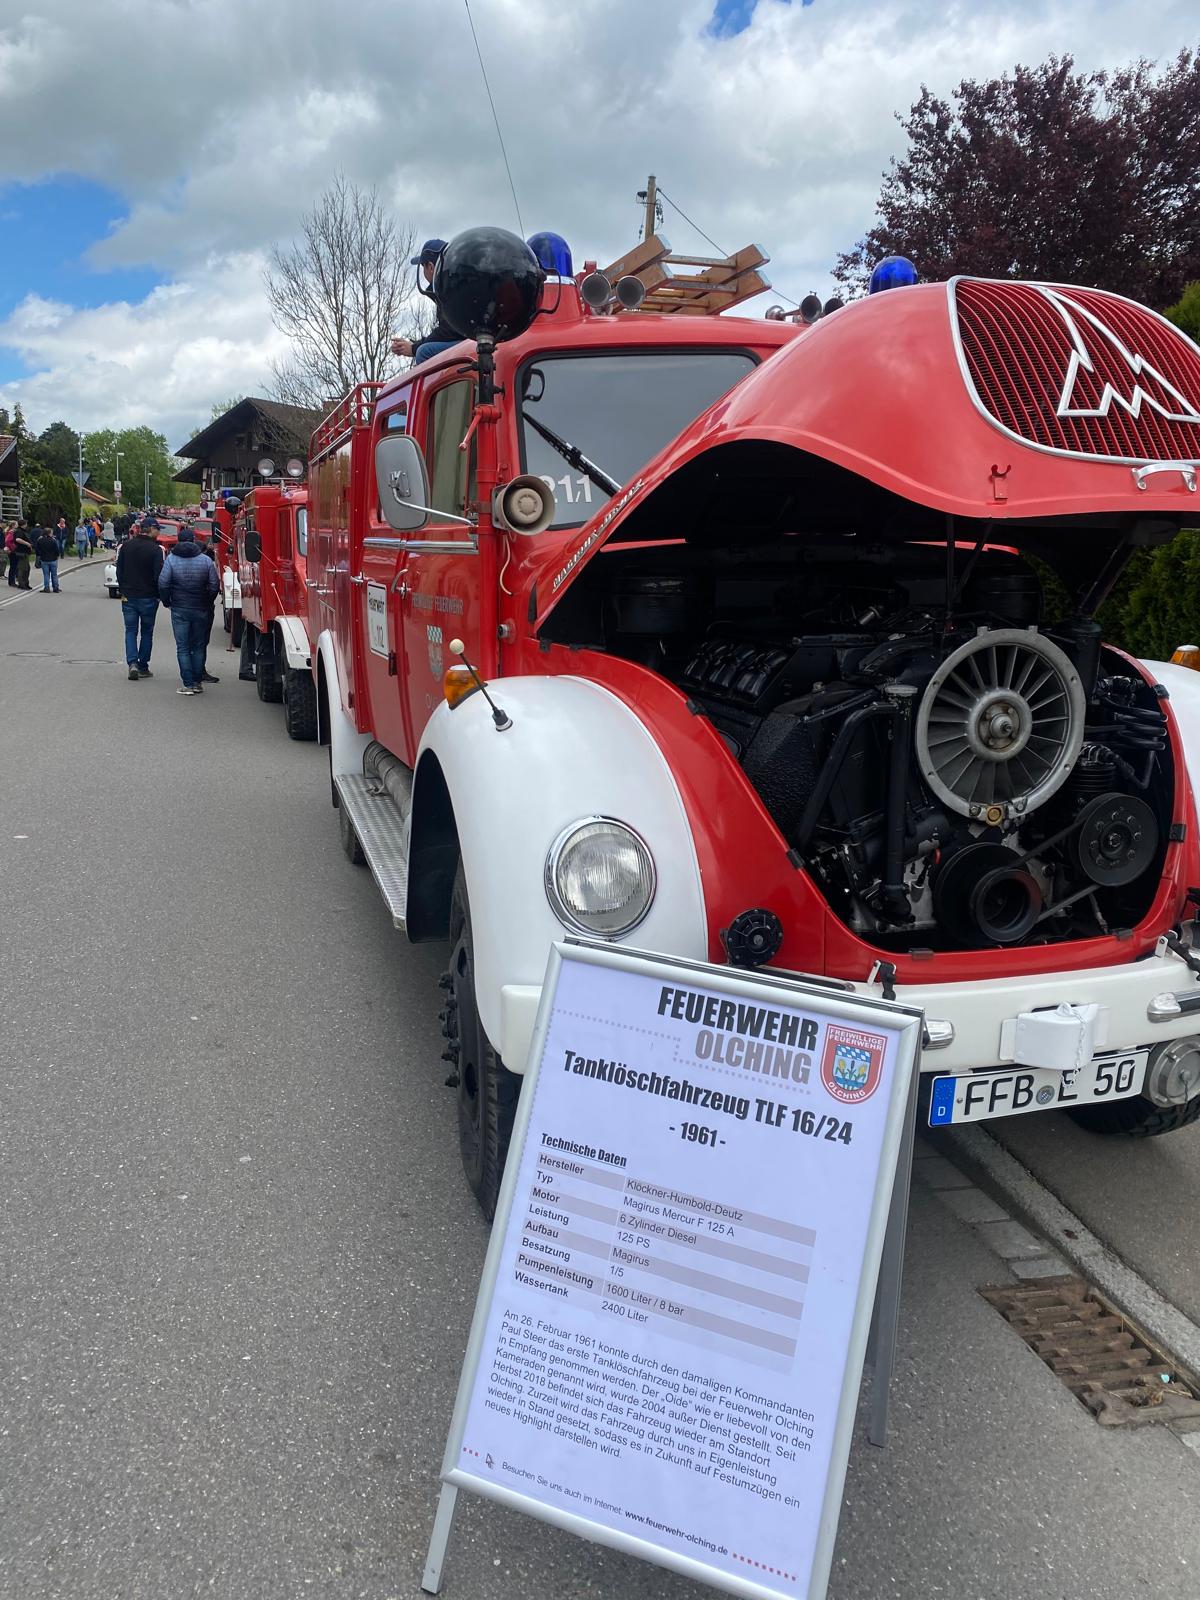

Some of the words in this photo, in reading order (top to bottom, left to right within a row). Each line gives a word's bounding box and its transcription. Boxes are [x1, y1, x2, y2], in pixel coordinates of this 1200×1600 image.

[657, 986, 818, 1051] FEUERWEHR
[829, 1034, 883, 1051] FEUERWEHR
[830, 1028, 883, 1046] FREIWILLIGE
[694, 1029, 811, 1085] OLCHING
[564, 1049, 750, 1120] Tanklöschfahrzeug
[755, 1098, 788, 1127] TLF
[791, 1108, 852, 1145] 16/24
[828, 1081, 866, 1099] OLCHING
[937, 1106, 946, 1117] D
[963, 1074, 1035, 1116] FFB
[1093, 1059, 1136, 1096] 50
[541, 1132, 596, 1158] Technische
[597, 1148, 627, 1167] Daten
[680, 1121, 717, 1147] 1961
[532, 1186, 560, 1203] Motor
[618, 1211, 626, 1223] 6
[627, 1215, 666, 1234] Zylinder
[667, 1227, 696, 1244] Diesel
[536, 1170, 553, 1184] Typ
[623, 1195, 660, 1215] Magirus
[662, 1207, 695, 1224] Mercur
[697, 1217, 704, 1227] F
[707, 1220, 725, 1234] 125
[726, 1226, 734, 1237] A
[539, 1153, 584, 1174] Hersteller
[627, 1179, 743, 1221] Klöckner-Humbold-Deutz
[524, 1220, 558, 1238] Aufbau
[612, 1247, 650, 1266] Magirus
[528, 1203, 569, 1226] Leistung
[617, 1230, 634, 1243] 125
[635, 1235, 650, 1248] PS
[518, 1253, 593, 1289] Pumpenleistung
[607, 1283, 630, 1298] 1600
[630, 1290, 652, 1305] Liter
[659, 1299, 666, 1310] 8
[667, 1301, 684, 1316] bar
[521, 1236, 570, 1262] Besatzung
[610, 1264, 624, 1277] 1/5
[515, 1270, 568, 1297] Wassertank
[601, 1300, 625, 1316] 2400
[626, 1308, 648, 1323] Liter
[498, 1333, 506, 1344] in
[508, 1337, 547, 1361] Empfang
[548, 1352, 599, 1378] genommen
[602, 1372, 639, 1392] werden.
[641, 1384, 659, 1398] Der
[694, 1403, 711, 1416] wie
[713, 1410, 724, 1420] er
[726, 1412, 767, 1436] liebevoll
[770, 1429, 788, 1444] von
[790, 1436, 810, 1451] den
[501, 1320, 521, 1336] Paul
[522, 1328, 547, 1344] Steer
[548, 1338, 564, 1351] das
[566, 1346, 590, 1360] erste
[592, 1352, 680, 1393] Tanklöschfahrzeug
[682, 1383, 698, 1396] bei
[699, 1390, 716, 1403] der
[718, 1395, 773, 1422] Feuerwehr
[774, 1415, 814, 1439] Olching
[503, 1308, 518, 1322] Am
[520, 1314, 533, 1327] 26.
[536, 1319, 571, 1340] Februar
[574, 1333, 596, 1348] 1961
[598, 1340, 629, 1360] konnte
[631, 1353, 658, 1370] durch
[660, 1362, 679, 1376] den
[681, 1370, 732, 1394] damaligen
[734, 1386, 814, 1422] Kommandanten
[484, 1399, 511, 1415] neues
[512, 1408, 552, 1432] Highlight
[553, 1421, 598, 1448] darstellen
[600, 1444, 622, 1459] wird.
[490, 1372, 524, 1394] Olching.
[527, 1385, 558, 1405] Zurzeit
[560, 1400, 579, 1413] wird
[580, 1406, 598, 1420] das
[600, 1412, 645, 1439] Fahrzeug
[647, 1430, 674, 1448] durch
[677, 1442, 695, 1455] uns
[697, 1447, 706, 1459] in
[709, 1451, 777, 1487] Eigenleistung
[492, 1358, 522, 1378] Herbst
[523, 1370, 546, 1386] 2018
[547, 1376, 583, 1400] befindet
[585, 1394, 604, 1408] sich
[606, 1401, 623, 1414] das
[626, 1407, 671, 1434] Fahrzeug
[674, 1425, 707, 1444] wieder
[708, 1437, 724, 1451] am
[727, 1441, 770, 1467] Standort
[495, 1346, 545, 1373] Kameraden
[546, 1362, 584, 1387] genannt
[586, 1381, 608, 1397] wird,
[610, 1389, 639, 1405] wurde
[641, 1398, 665, 1415] 2004
[668, 1409, 697, 1425] außer
[699, 1418, 731, 1438] Dienst
[732, 1432, 771, 1453] gestellt.
[775, 1445, 796, 1461] Seit
[487, 1386, 516, 1403] wieder
[517, 1396, 526, 1407] in
[527, 1400, 555, 1417] Stand
[556, 1413, 591, 1434] gesetzt,
[593, 1427, 628, 1444] sodass
[629, 1436, 643, 1450] es
[643, 1443, 653, 1454] in
[655, 1447, 692, 1468] Zukunft
[694, 1463, 712, 1474] auf
[712, 1465, 781, 1502] Festumzügen
[784, 1495, 800, 1508] ein
[501, 1461, 535, 1480] Besuchen
[536, 1475, 548, 1486] Sie
[549, 1482, 562, 1492] uns
[563, 1488, 581, 1499] auch
[583, 1495, 592, 1504] im
[624, 1510, 728, 1555] www.feuerwehr-olching.de
